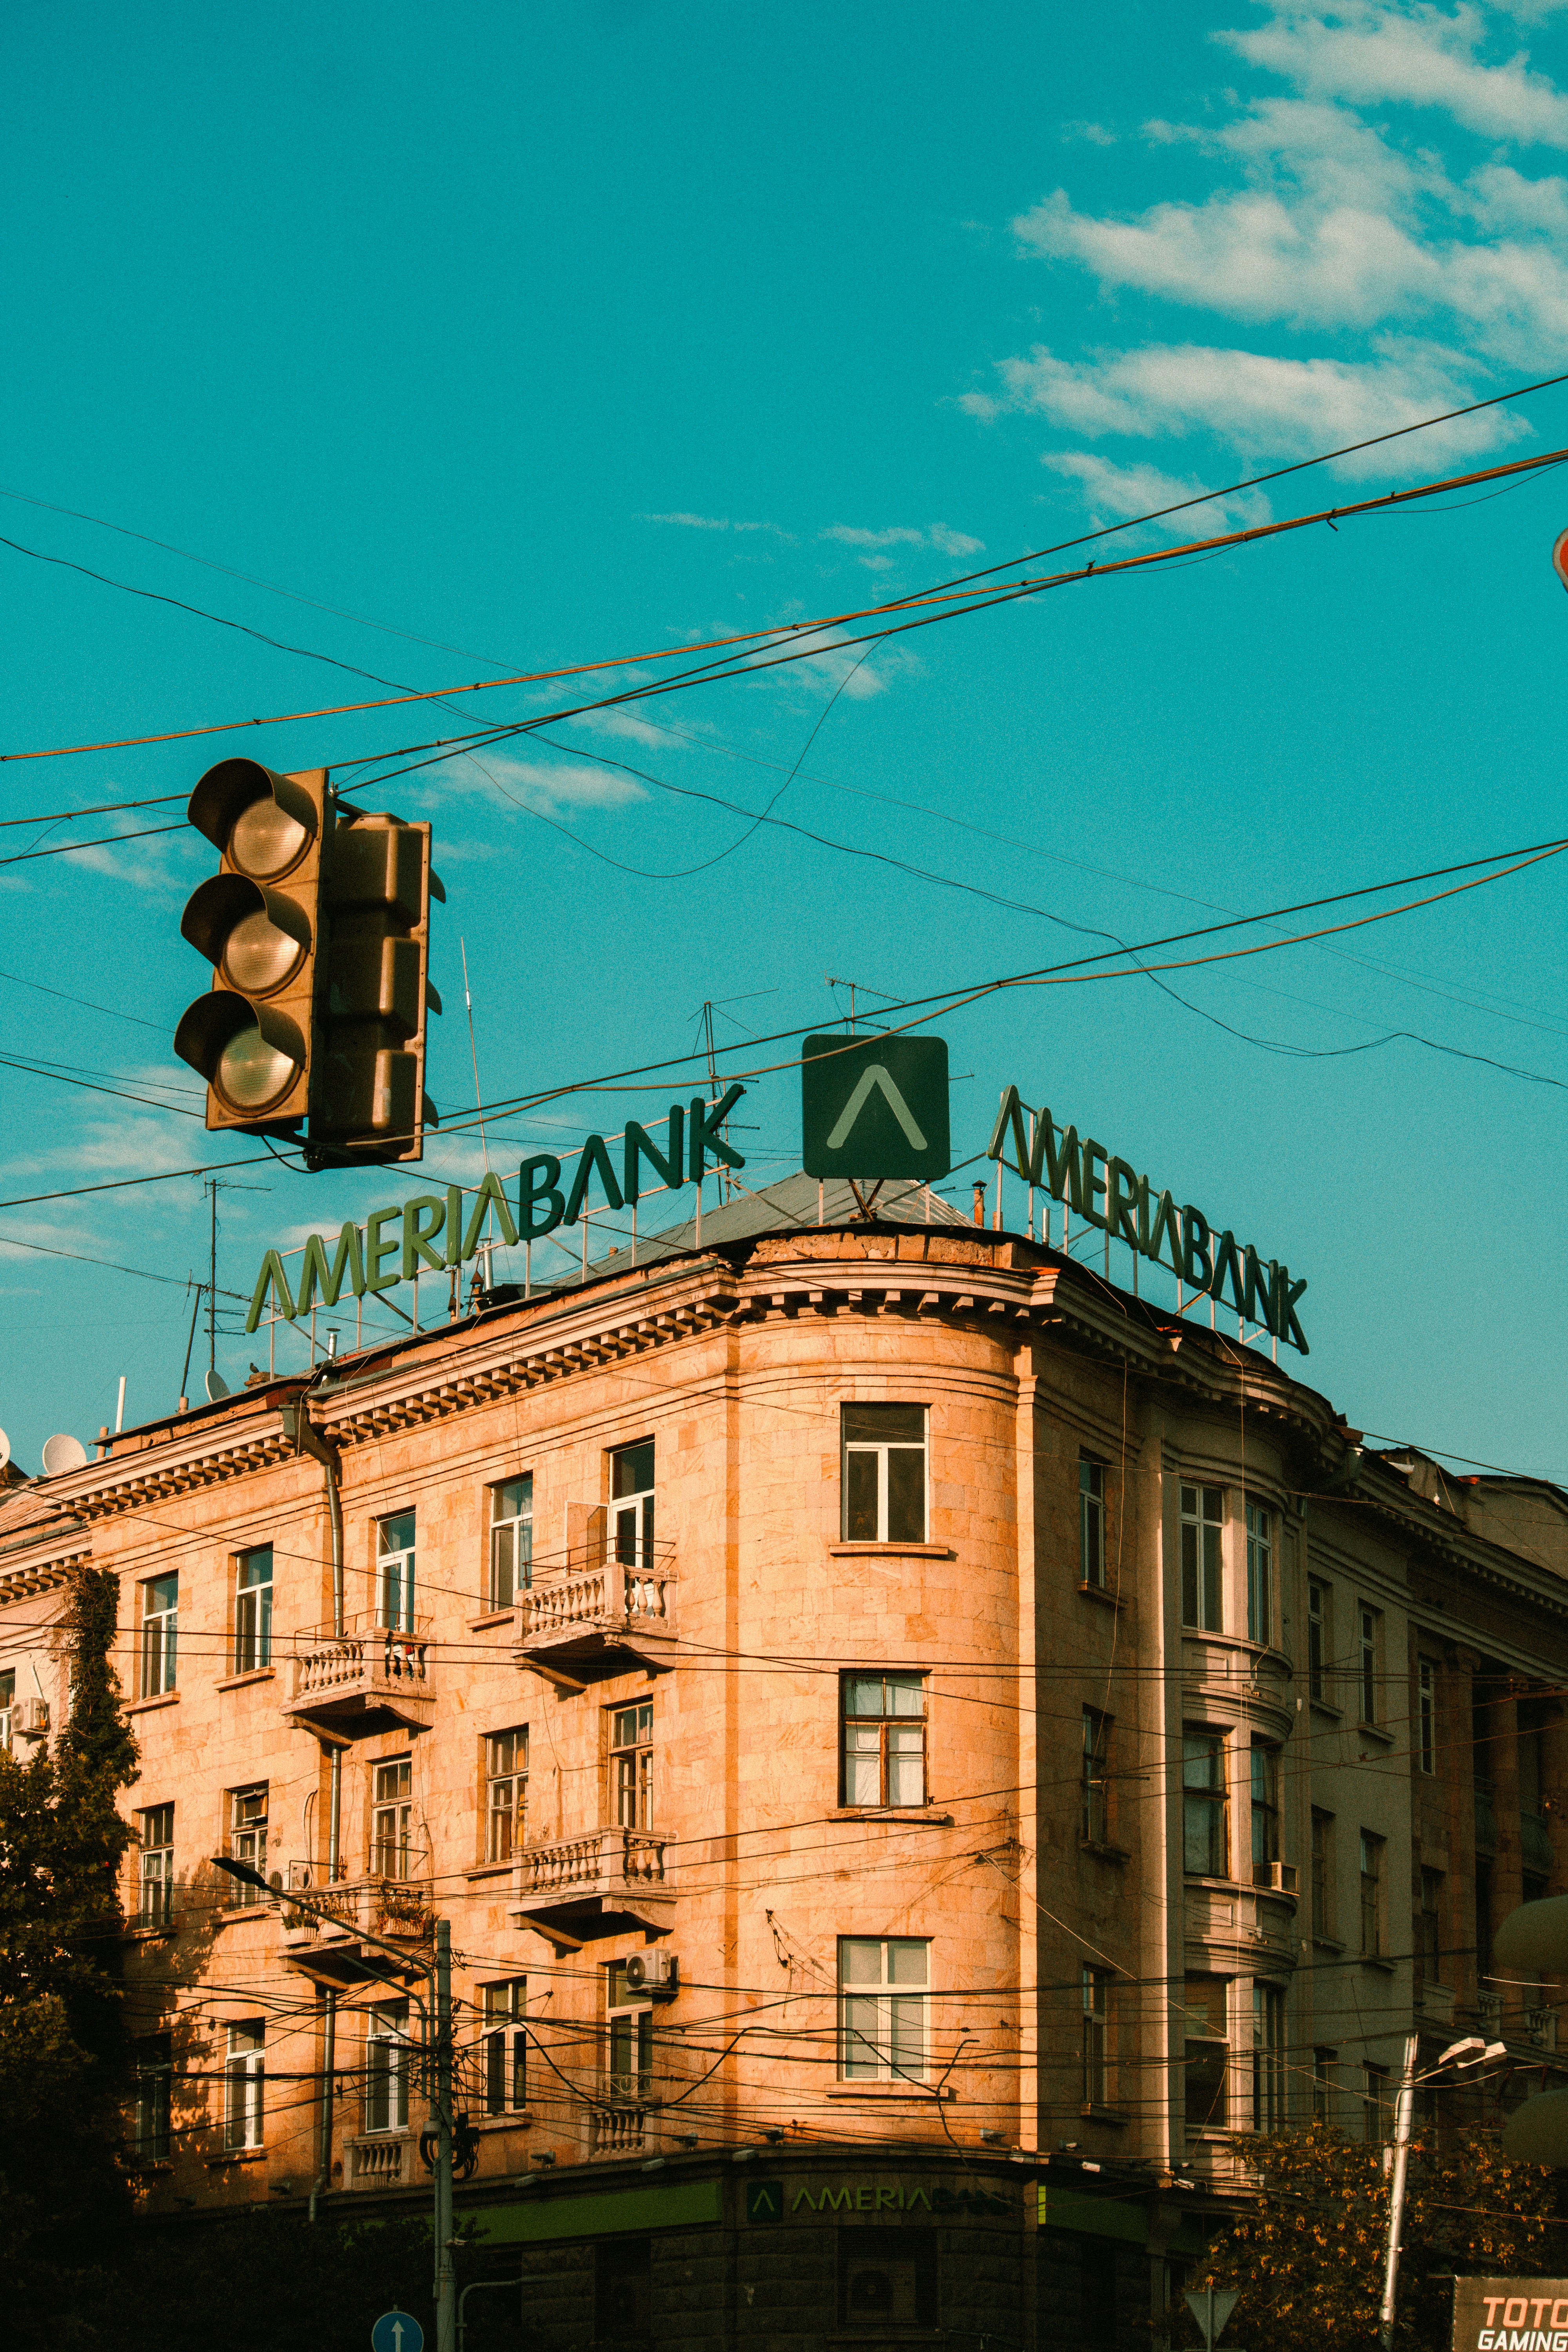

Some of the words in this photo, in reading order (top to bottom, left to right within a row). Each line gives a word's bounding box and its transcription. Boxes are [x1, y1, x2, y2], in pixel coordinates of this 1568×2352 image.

[245, 1083, 746, 1334] AMERIABANK
[987, 1084, 1309, 1356] AMERIABANK
[1477, 2330, 1568, 2352] GAMING
[1483, 2297, 1568, 2328] TOTO
